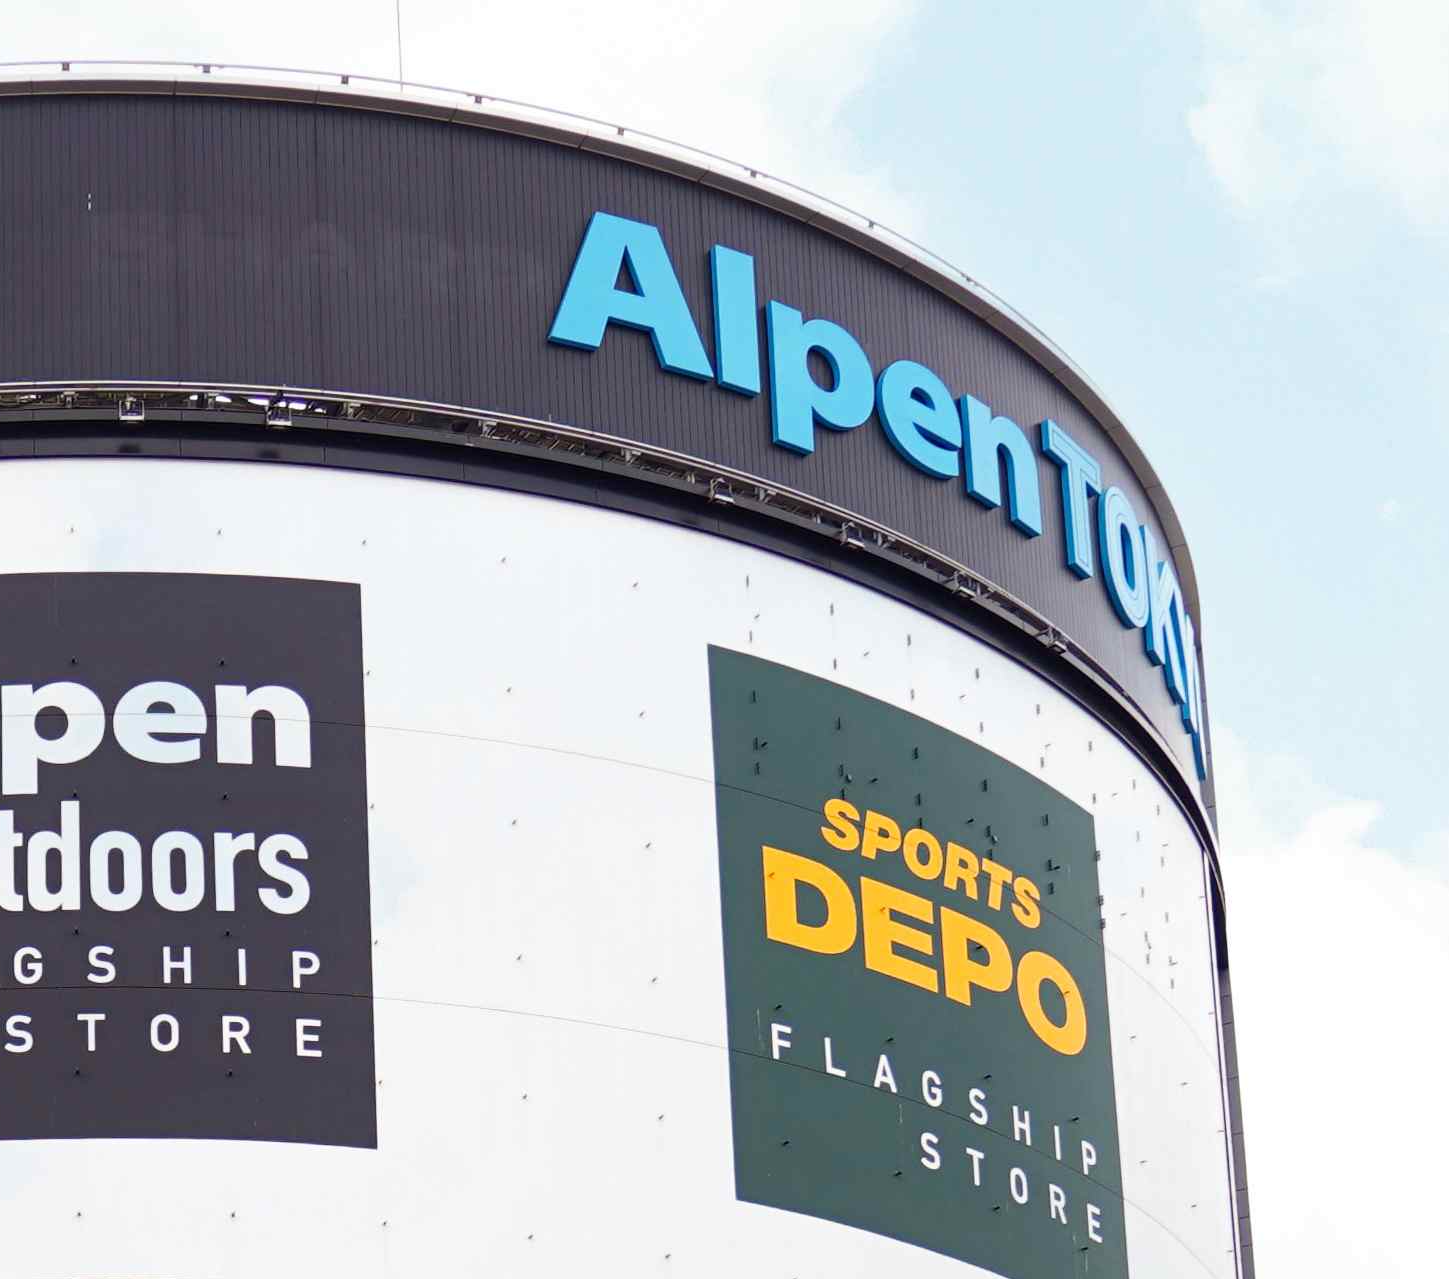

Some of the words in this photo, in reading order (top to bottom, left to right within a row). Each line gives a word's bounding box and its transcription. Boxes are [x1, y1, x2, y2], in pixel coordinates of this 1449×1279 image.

[547, 209, 1042, 539] Alpen
[819, 798, 1042, 930] SPORTS
[761, 845, 1087, 1057] DEPO
[3, 1013, 323, 1058] STORE
[770, 1022, 1099, 1176] FLAGSHIP
[920, 1134, 1103, 1243] STORE
